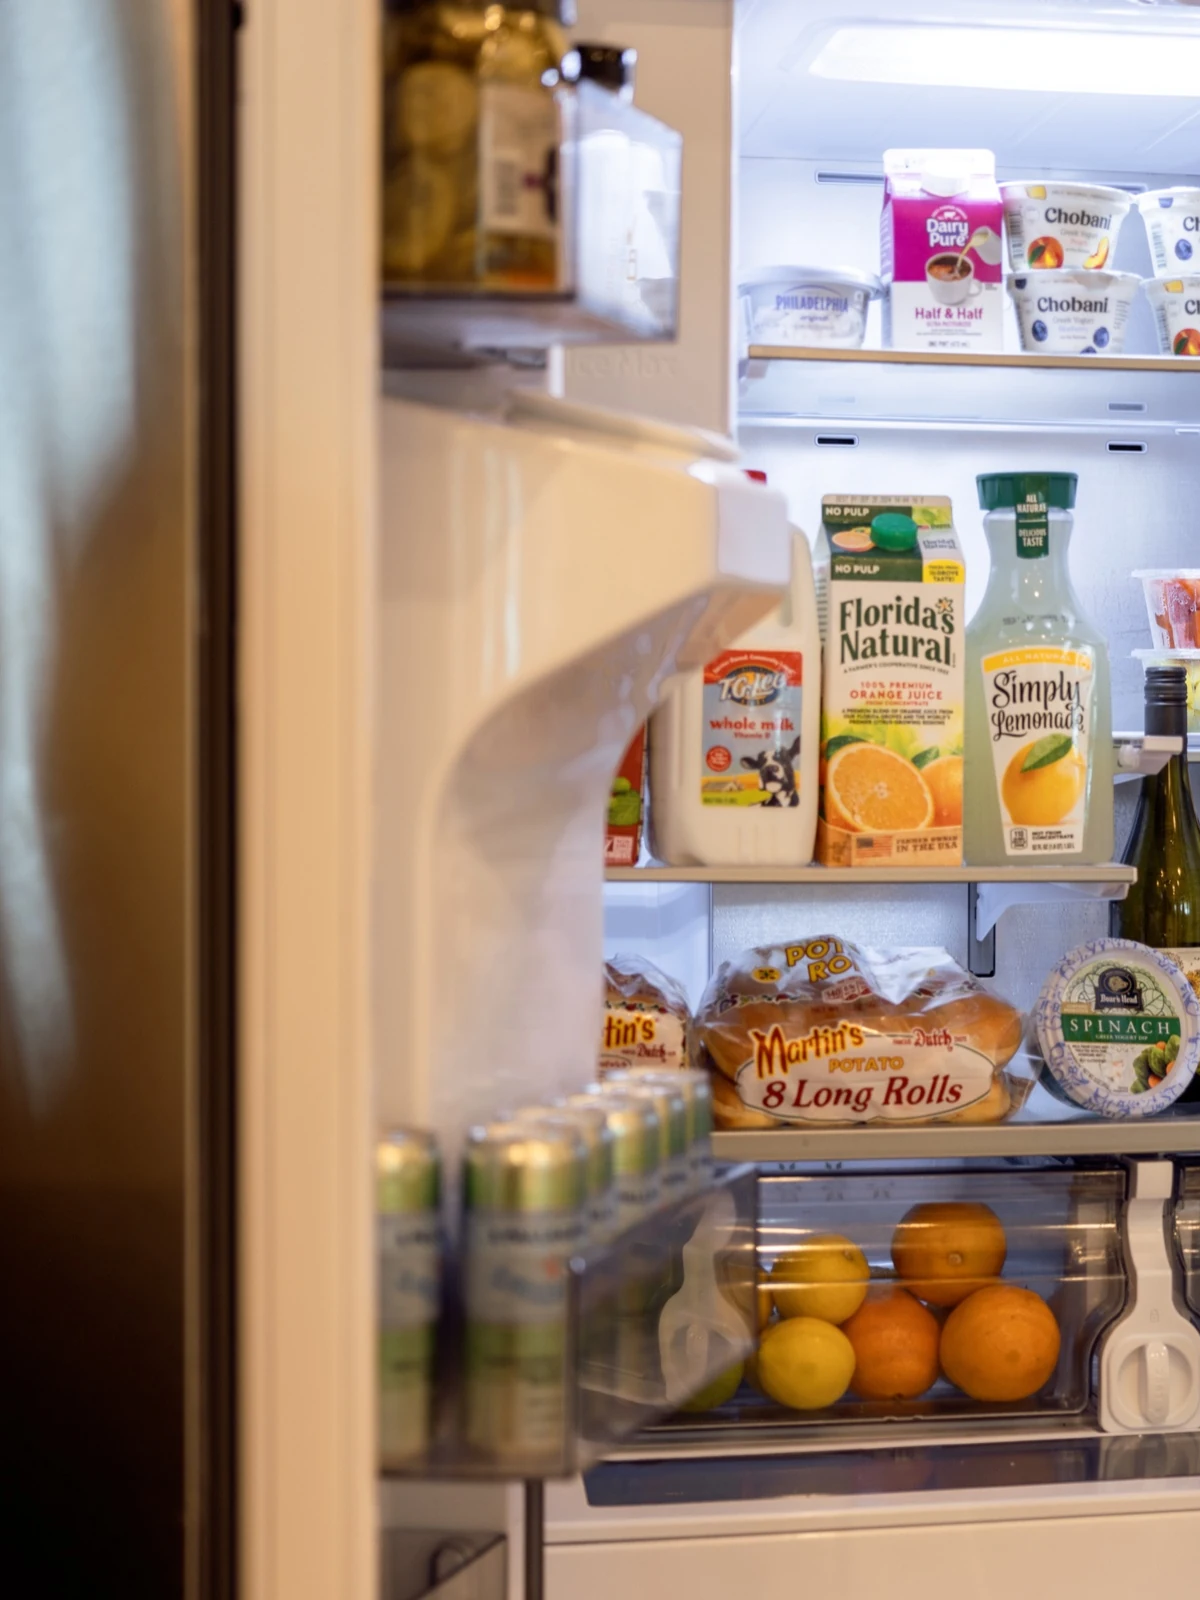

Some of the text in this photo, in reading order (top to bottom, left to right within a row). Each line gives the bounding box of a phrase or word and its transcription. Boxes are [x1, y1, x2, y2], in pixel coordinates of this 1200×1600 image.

[1044, 207, 1112, 231] Chobani
[926, 218, 968, 238] Dairy
[929, 231, 967, 248] Pure
[775, 295, 849, 313] PHILADELPHIA
[1037, 296, 1109, 313] Chobani
[914, 307, 983, 320] Half & Half
[1025, 493, 1037, 503] ALL
[825, 507, 870, 517] NO PULP
[1018, 528, 1047, 537] DELICIOUS
[1022, 537, 1043, 546] TASTE
[835, 564, 880, 574] NO PULP
[840, 595, 955, 636] Florida's
[840, 628, 951, 667] Natural
[860, 681, 886, 689] 100%
[992, 669, 1085, 711] Simply
[849, 689, 943, 701] ORANGE JUICE
[709, 716, 795, 732] whole mlk
[991, 709, 1084, 742] Lemonade
[896, 841, 958, 853] IN THE USA
[1070, 1018, 1171, 1035] SPINACH
[913, 1027, 953, 1052] Dutch
[751, 1020, 866, 1080] Martin's
[828, 1055, 905, 1073] POTATO
[762, 1074, 964, 1113] 8 Long Rolls
